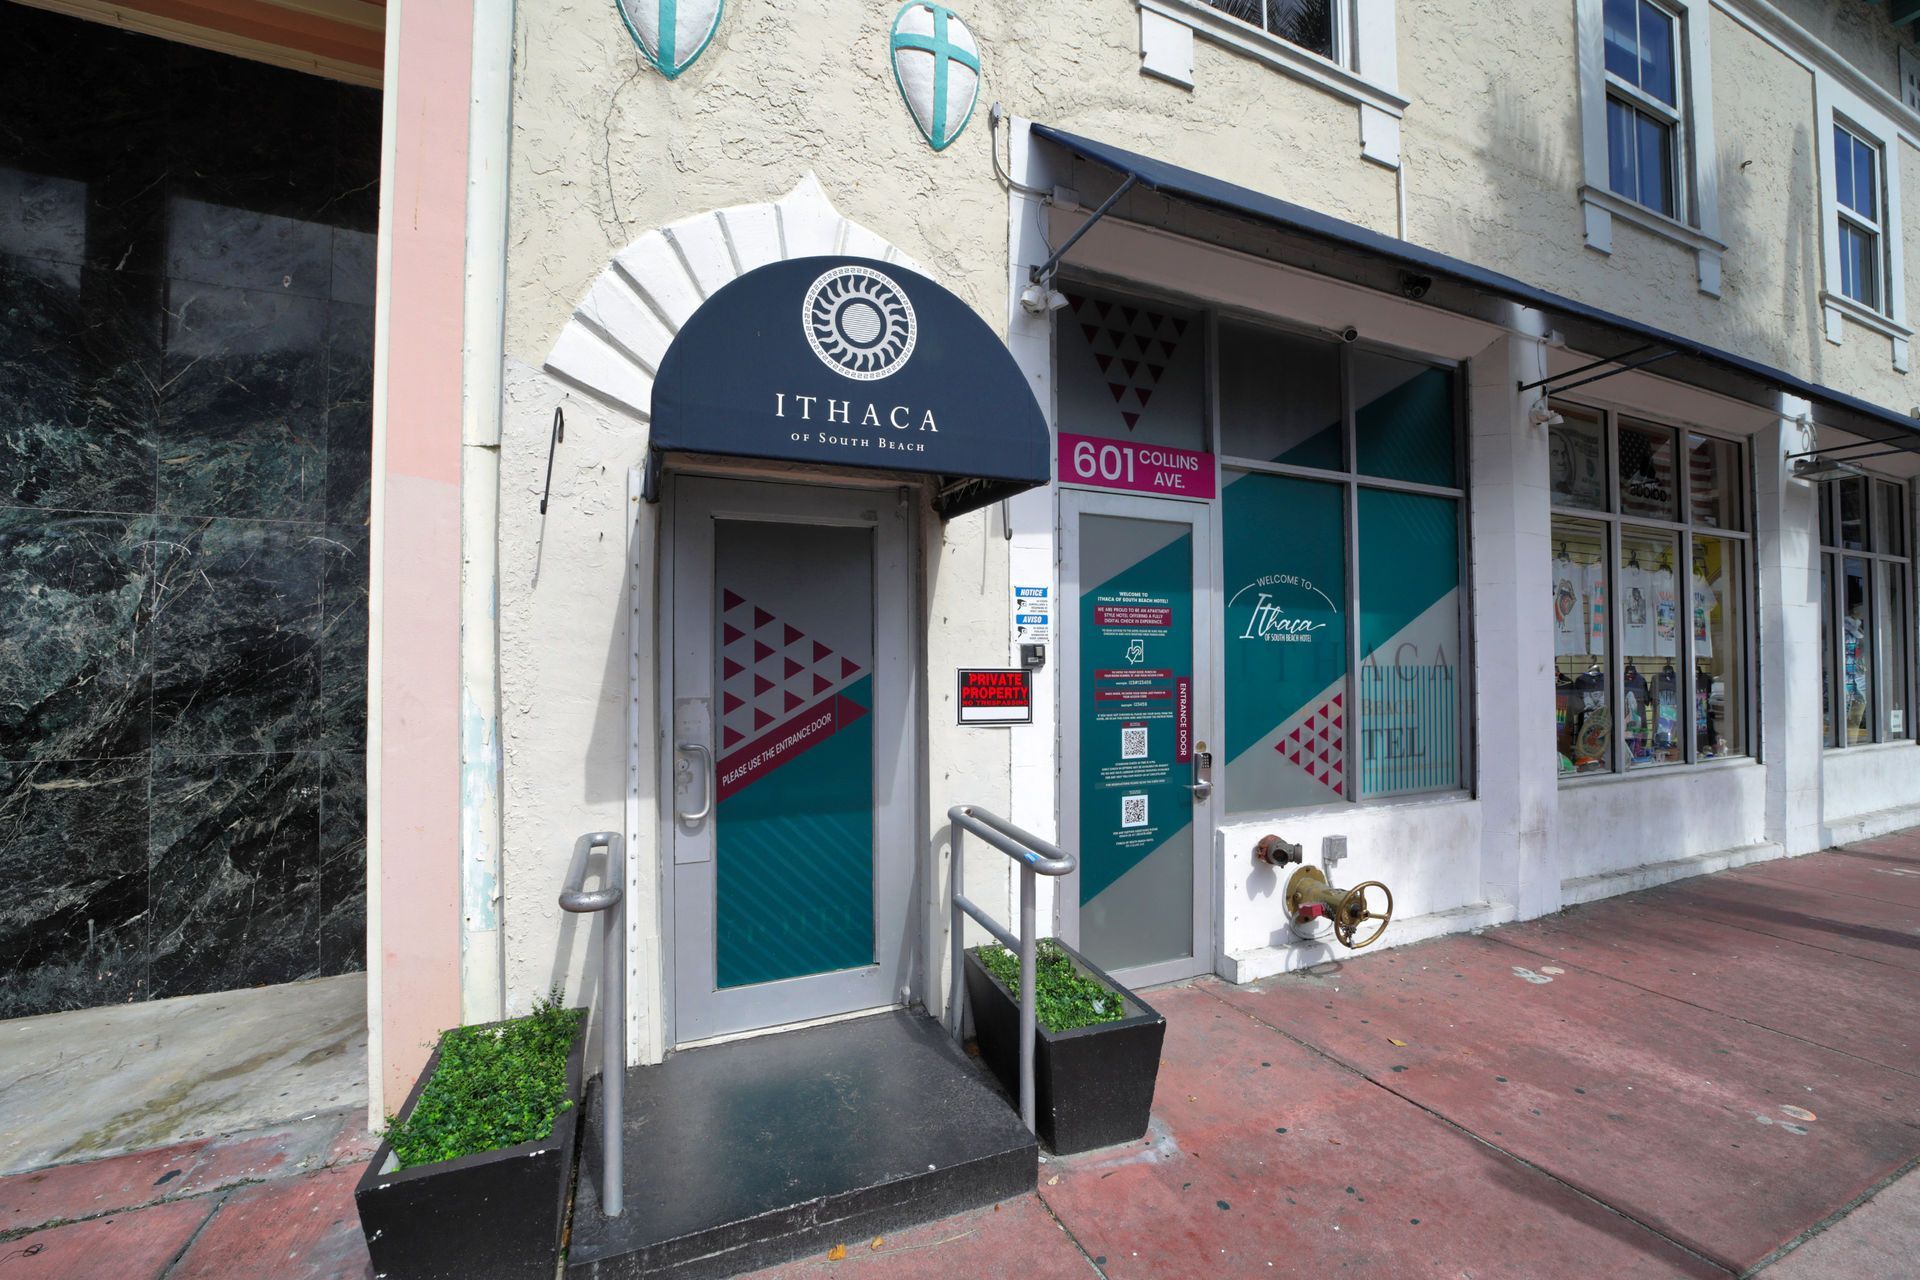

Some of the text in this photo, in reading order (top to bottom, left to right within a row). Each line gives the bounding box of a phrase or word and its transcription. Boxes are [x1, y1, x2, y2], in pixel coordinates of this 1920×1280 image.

[775, 393, 939, 432] ITHACA
[1073, 441, 1135, 483] 601
[1139, 450, 1199, 471] COLLINS
[1154, 472, 1186, 489] AVE.
[1256, 574, 1312, 590] WELCOME TO
[1020, 588, 1043, 597] NOTICE
[1022, 615, 1043, 624] AVISO
[1239, 593, 1326, 639] Ithaca
[969, 672, 1023, 686] PRIVATE
[962, 686, 1029, 699] PROPERTY
[722, 712, 833, 787] PLEASE USE THE ENTRANCE DOOR
